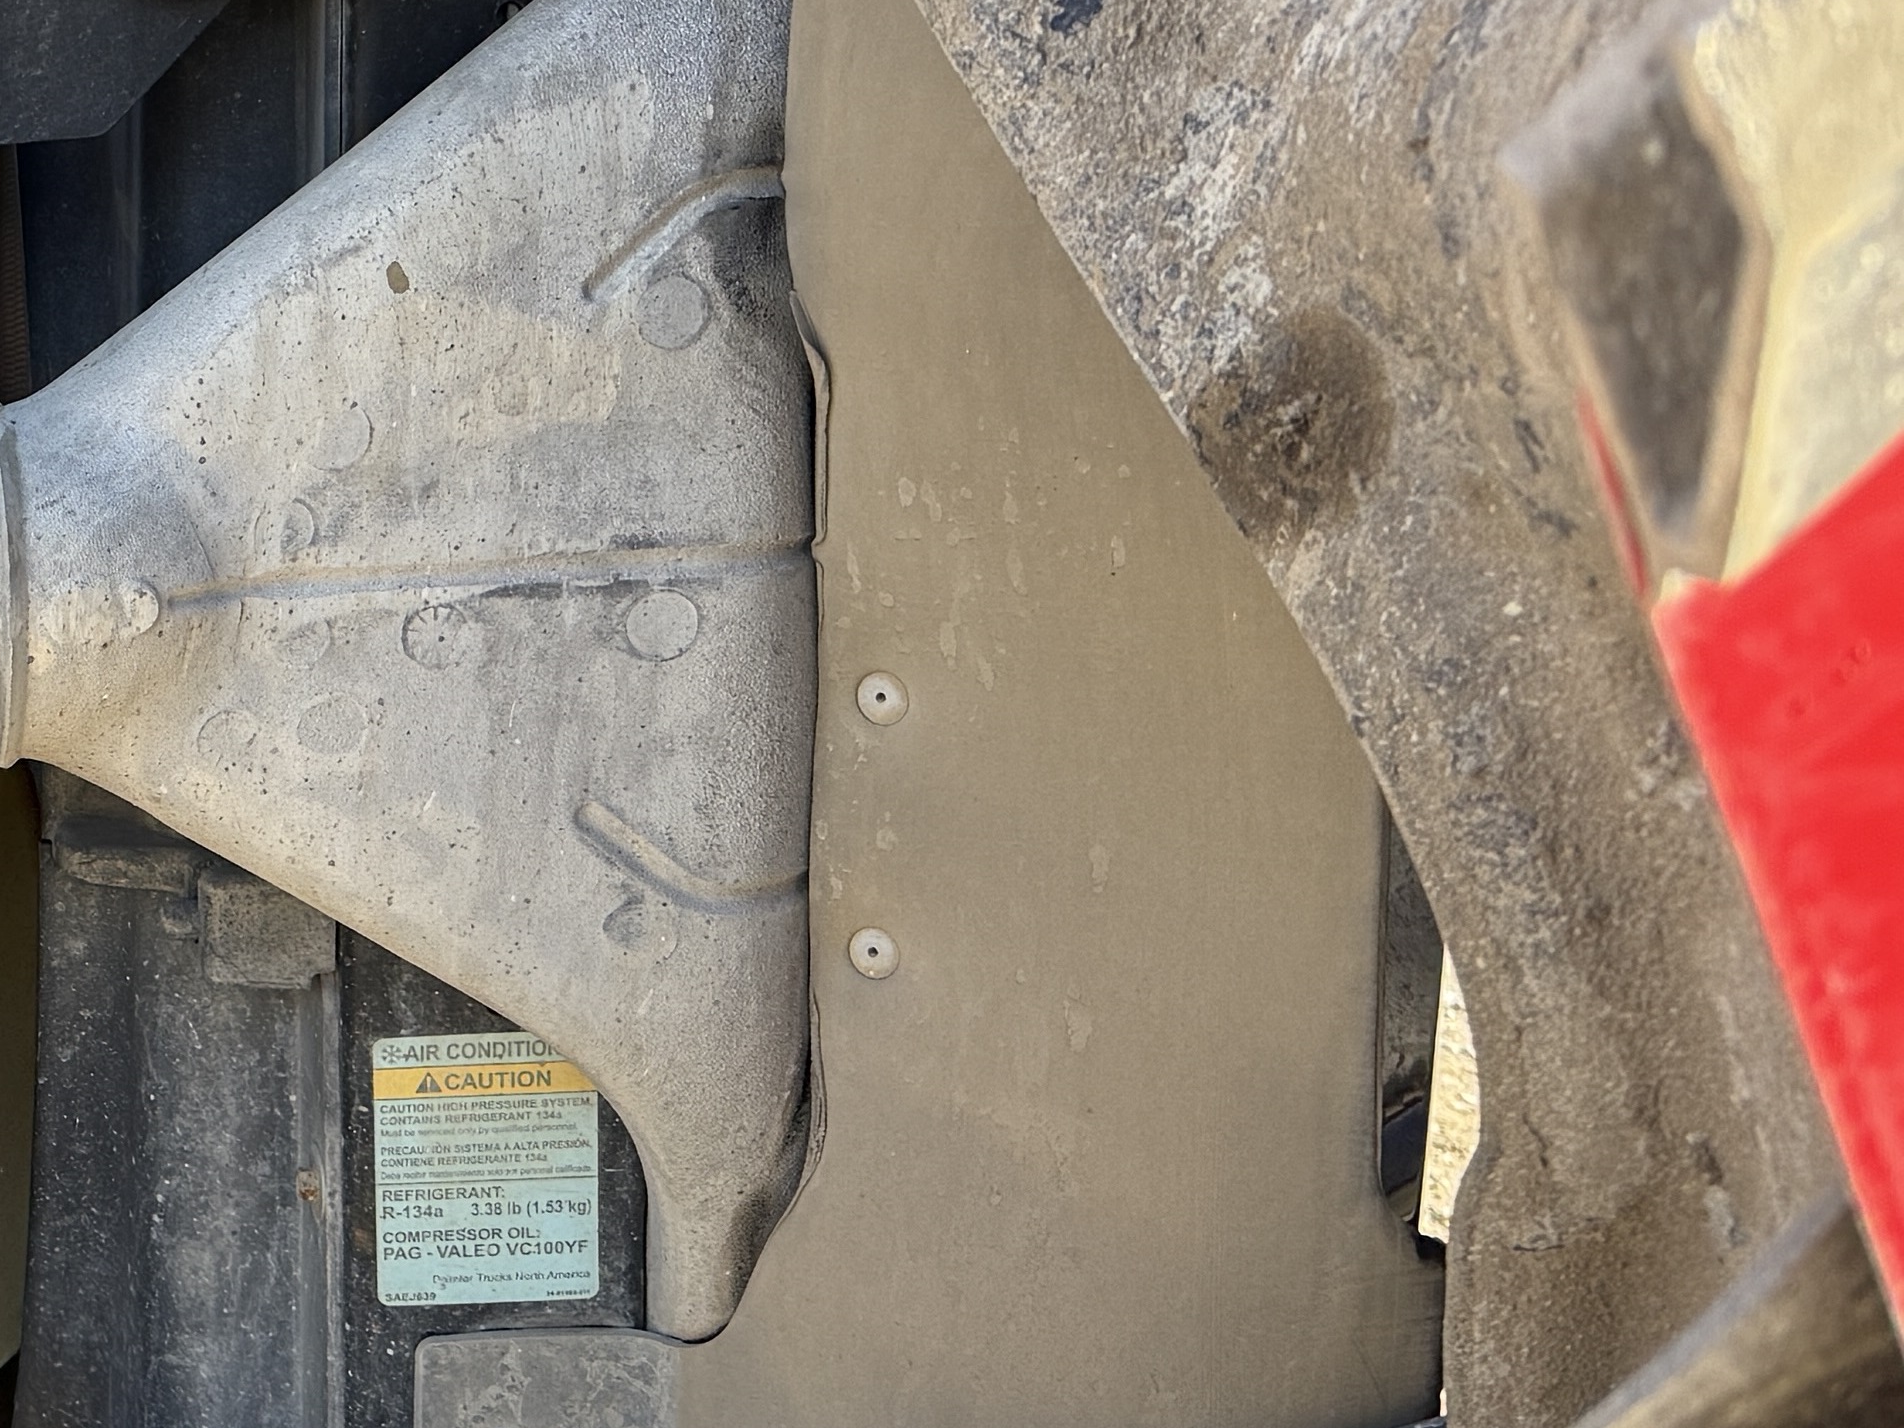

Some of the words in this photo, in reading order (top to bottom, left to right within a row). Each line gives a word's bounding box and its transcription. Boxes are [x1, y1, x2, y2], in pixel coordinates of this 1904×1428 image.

[405, 1044, 441, 1062] AIR
[444, 1070, 552, 1090] CAUTION
[380, 1103, 434, 1114] CAUTION
[438, 1102, 468, 1112] HIGH
[471, 1099, 537, 1111] PRESSURE
[380, 1115, 441, 1126] CONTAINS
[444, 1111, 532, 1123] REFRIGERANT
[454, 1143, 502, 1153] SISTEMA
[513, 1141, 540, 1151] ALTA
[380, 1157, 435, 1168] CONTIENE
[382, 1186, 505, 1202] REFRIGERANT:
[382, 1205, 444, 1220] R-134a
[471, 1202, 503, 1216] 3.38
[507, 1201, 522, 1215] lb
[526, 1199, 564, 1217] (1.53
[567, 1198, 592, 1216] kg)
[382, 1227, 503, 1244] COMPRESSOR
[507, 1227, 541, 1239] OIL:
[383, 1246, 422, 1260] PAG
[437, 1243, 500, 1258] VALEO
[506, 1240, 588, 1256] VC100YF
[476, 1272, 513, 1282] Trucks
[515, 1271, 543, 1281] North
[546, 1270, 591, 1280] America
